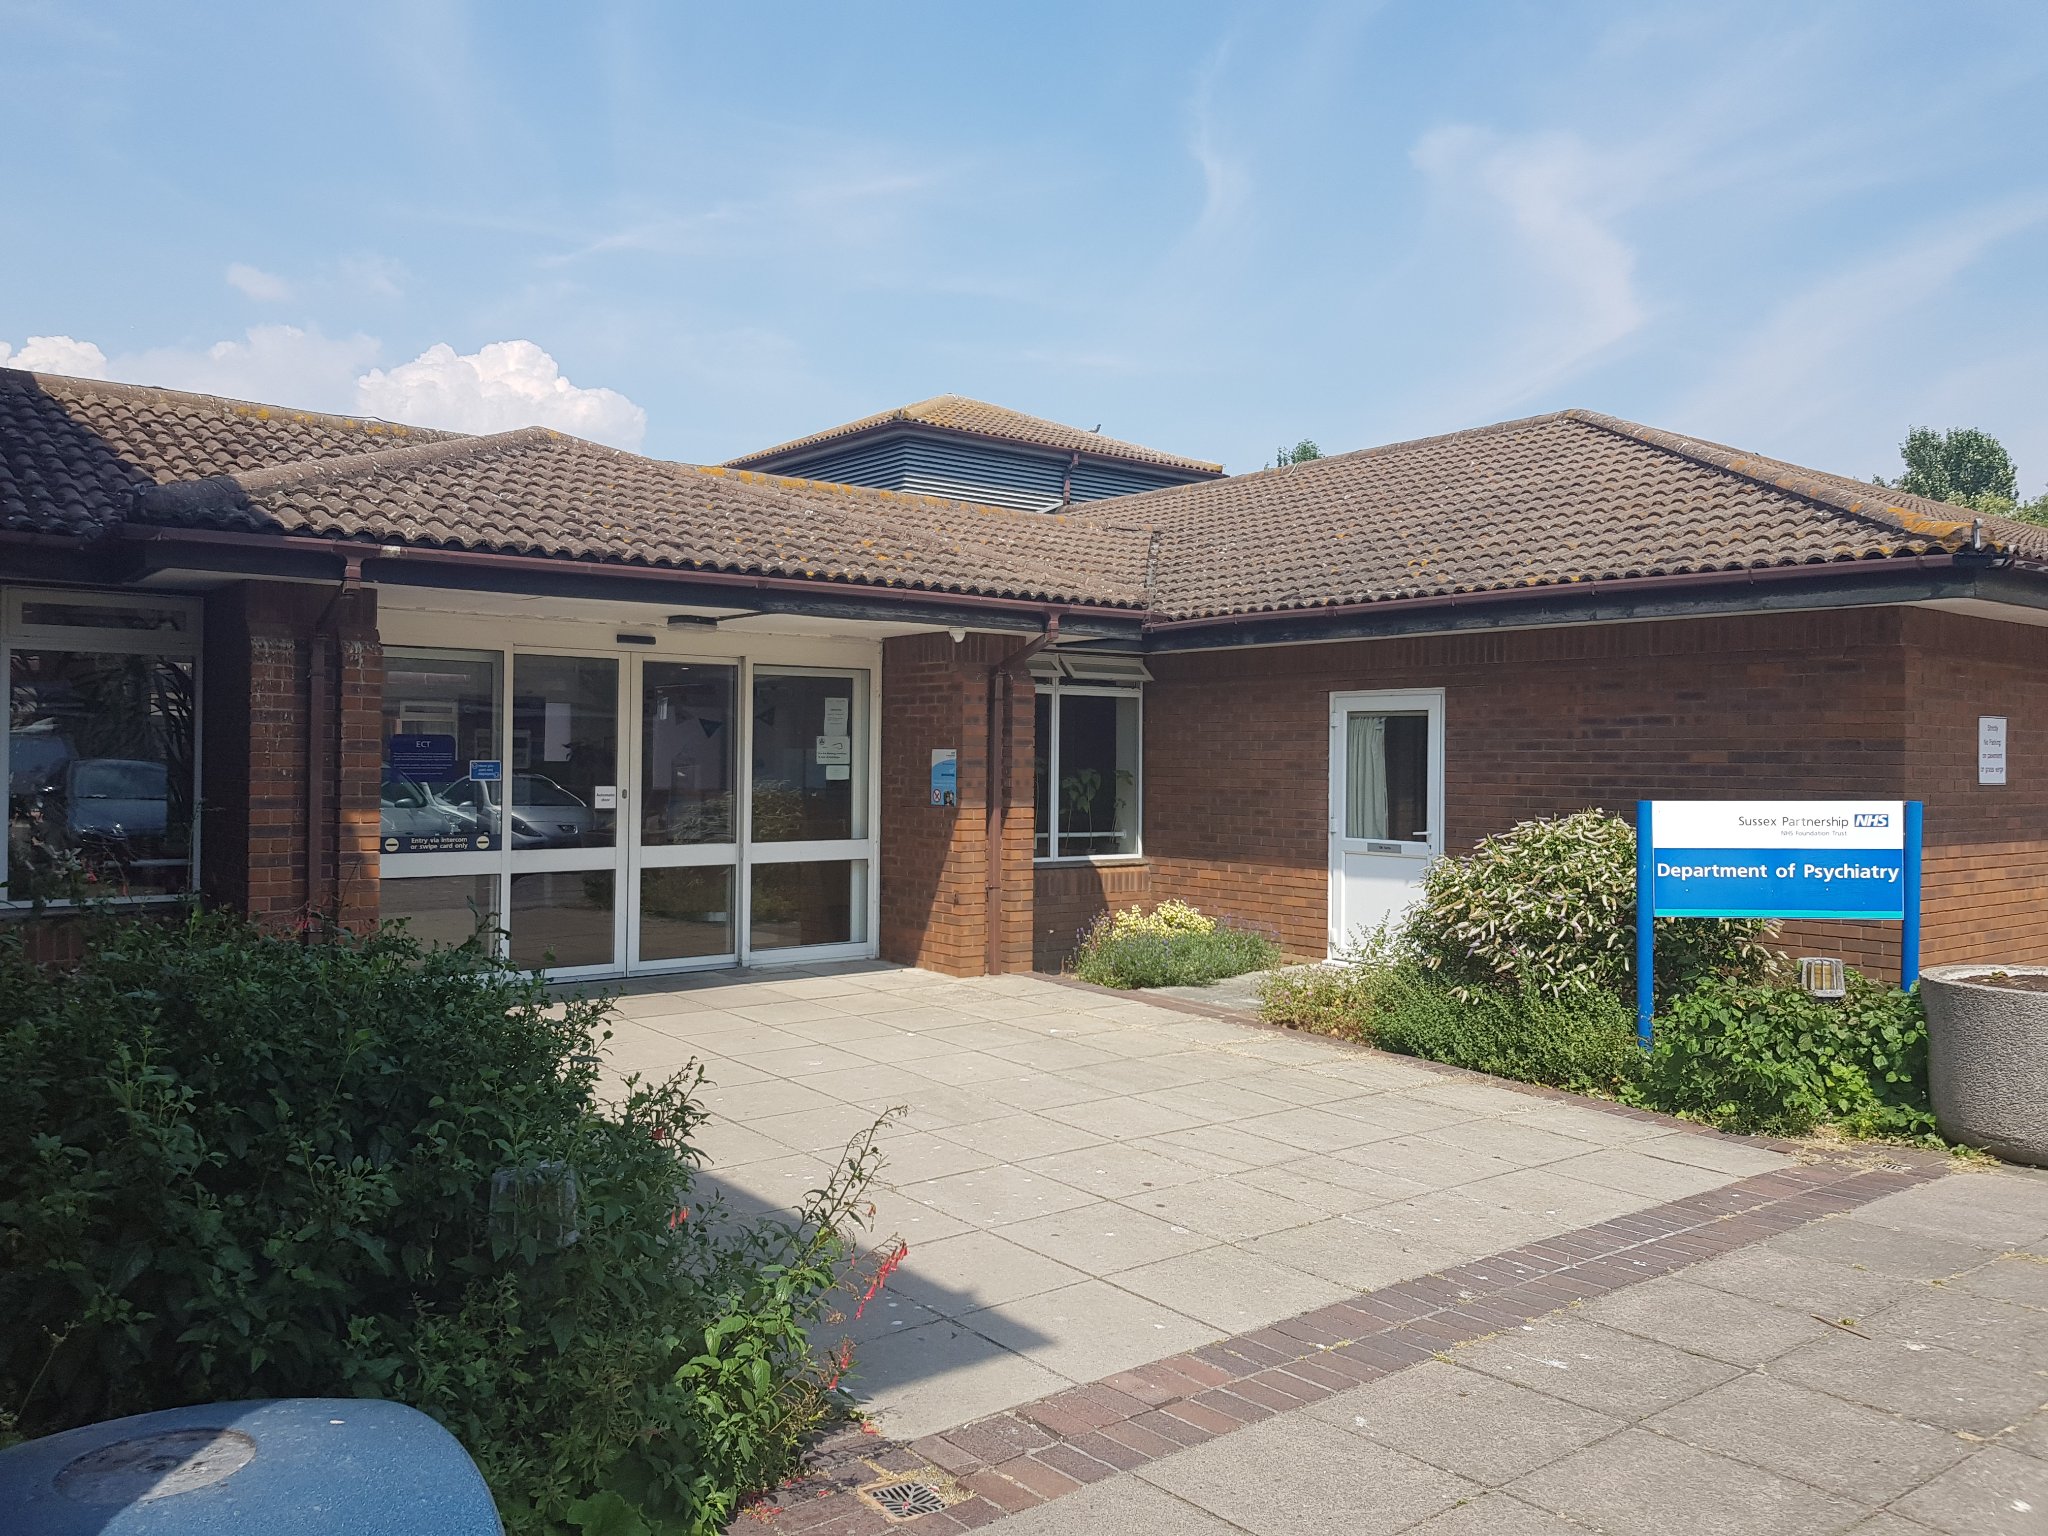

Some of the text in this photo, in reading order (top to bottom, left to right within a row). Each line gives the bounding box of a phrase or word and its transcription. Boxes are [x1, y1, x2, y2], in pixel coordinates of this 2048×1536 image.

[1738, 814, 1888, 830] Sussex Partnership NHS
[1657, 864, 1900, 882] Department of Psychiatry
